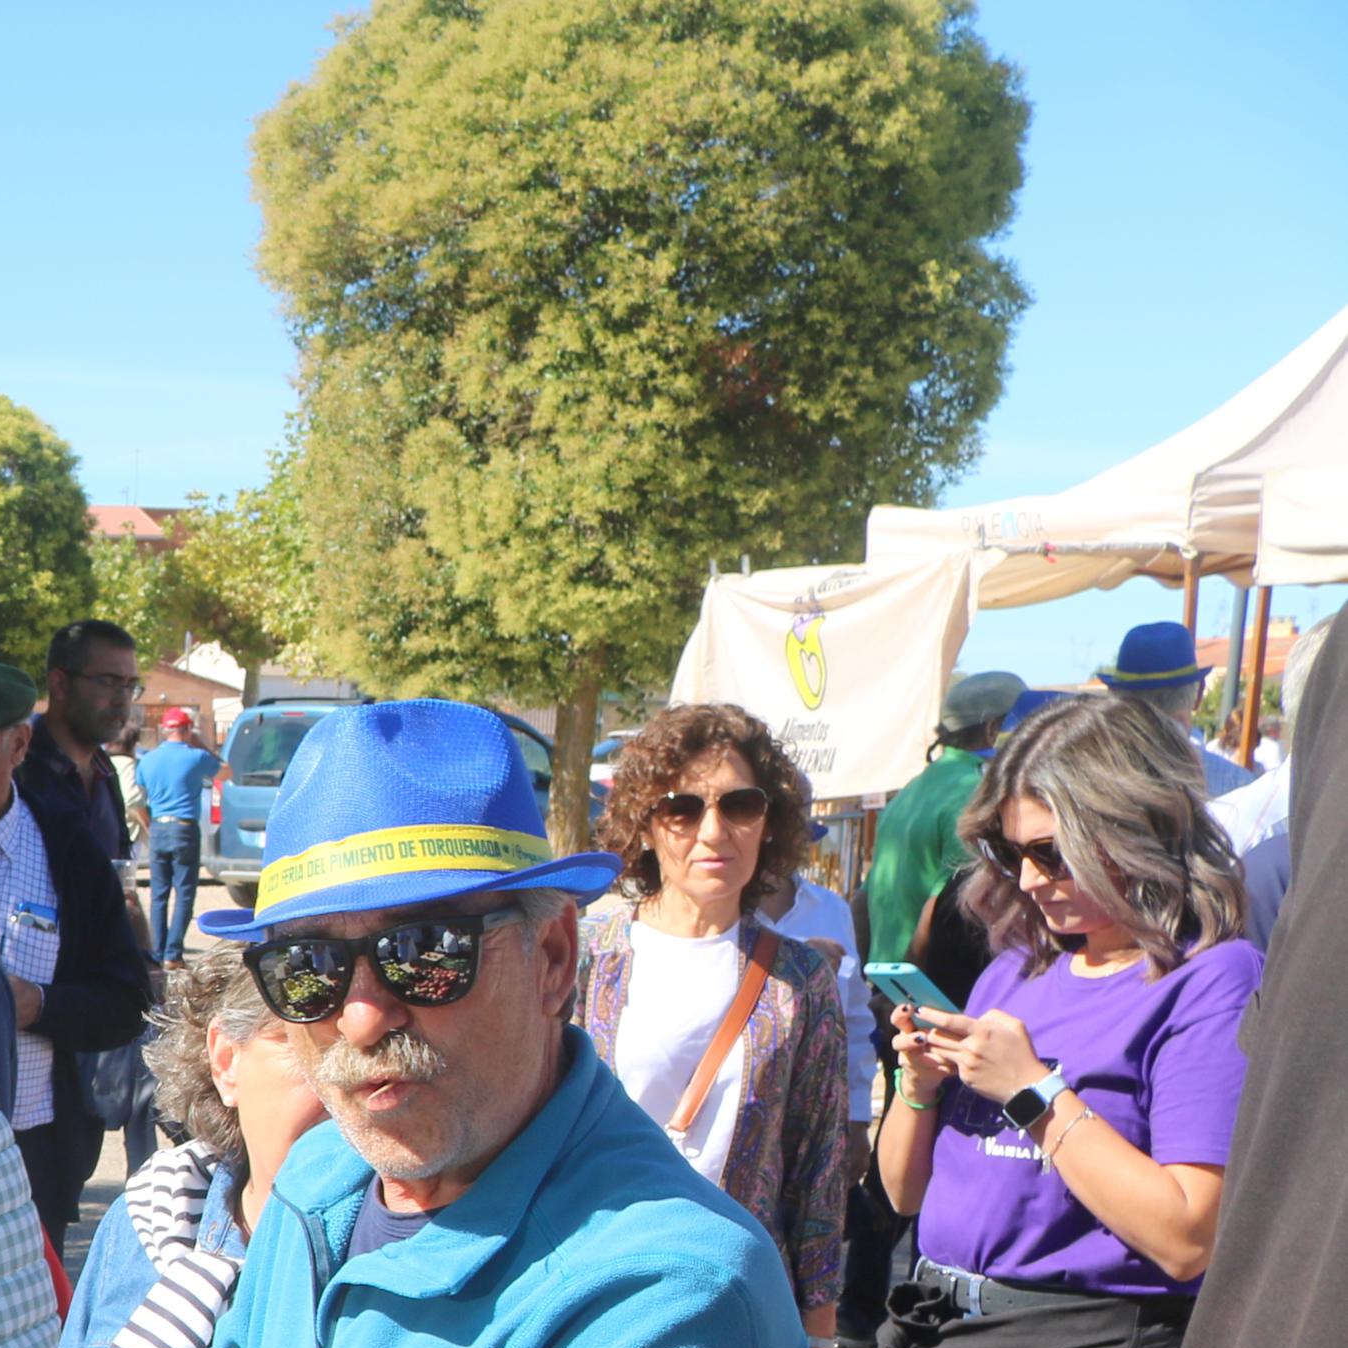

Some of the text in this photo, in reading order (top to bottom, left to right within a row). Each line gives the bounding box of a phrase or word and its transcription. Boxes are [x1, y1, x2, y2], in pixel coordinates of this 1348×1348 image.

[307, 856, 326, 878] DEL
[330, 843, 395, 872] PIMIENTO
[399, 840, 417, 858] DE
[419, 839, 502, 859] TORQUEMADA
